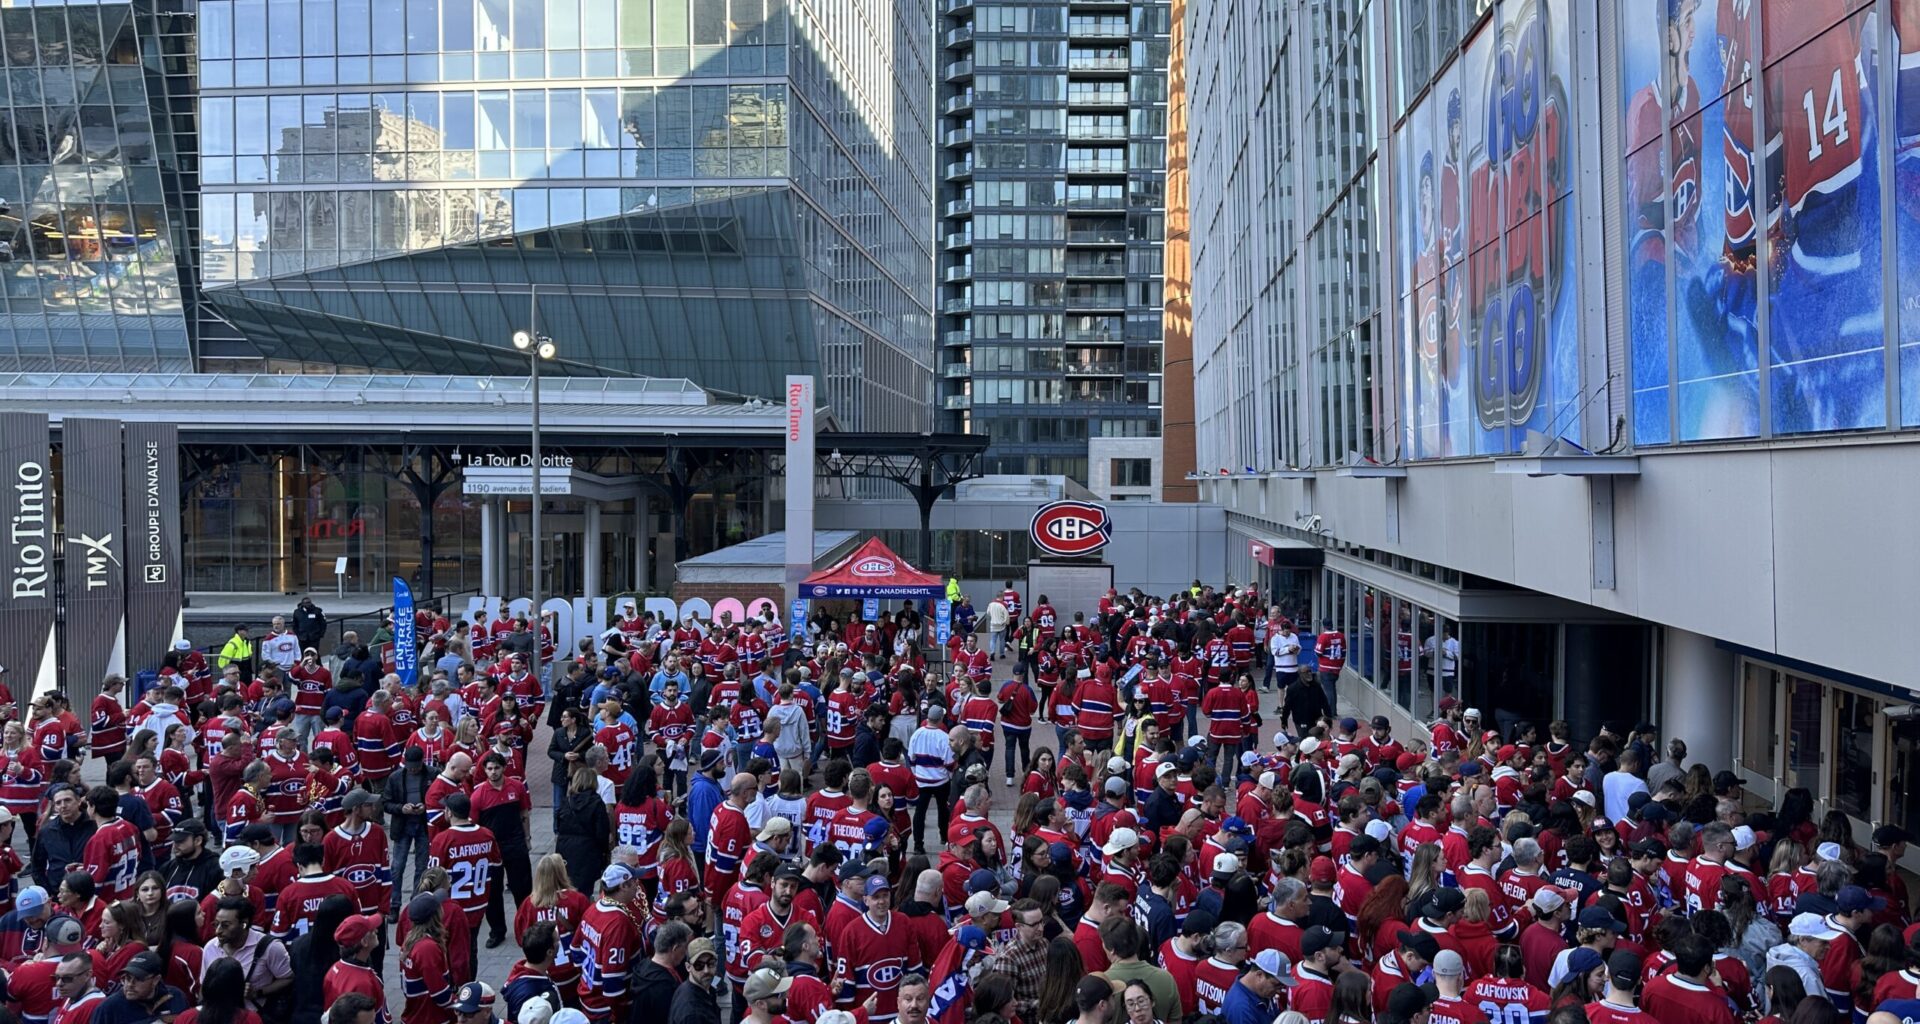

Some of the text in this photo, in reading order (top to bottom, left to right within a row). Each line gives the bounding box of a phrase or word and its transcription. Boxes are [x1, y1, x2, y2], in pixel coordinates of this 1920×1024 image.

[1487, 16, 1539, 167] GO
[1803, 68, 1849, 162] 14
[1471, 103, 1558, 320] HABS
[1482, 283, 1534, 401] GO
[468, 453, 573, 467] La Tour Dloitte
[467, 484, 566, 493] 1190 avenue des nadiens
[147, 441, 161, 561] GROUPE D'ANALYSE
[12, 461, 48, 599] Rio Tinto
[68, 533, 121, 591] TMX
[396, 607, 406, 670] ENTRÉE
[405, 606, 414, 670] ENTRANCE
[43, 734, 57, 745] 48
[1440, 741, 1452, 751] 22
[169, 797, 182, 808] 93
[231, 804, 246, 817] 14
[728, 839, 737, 852] 6
[451, 858, 489, 900] 20
[675, 878, 689, 893] 93
[1500, 881, 1527, 901] AFLEUR
[1492, 904, 1509, 922] 13
[609, 948, 625, 964] 20
[837, 957, 846, 973] 6
[1196, 978, 1226, 1005] HUTSON
